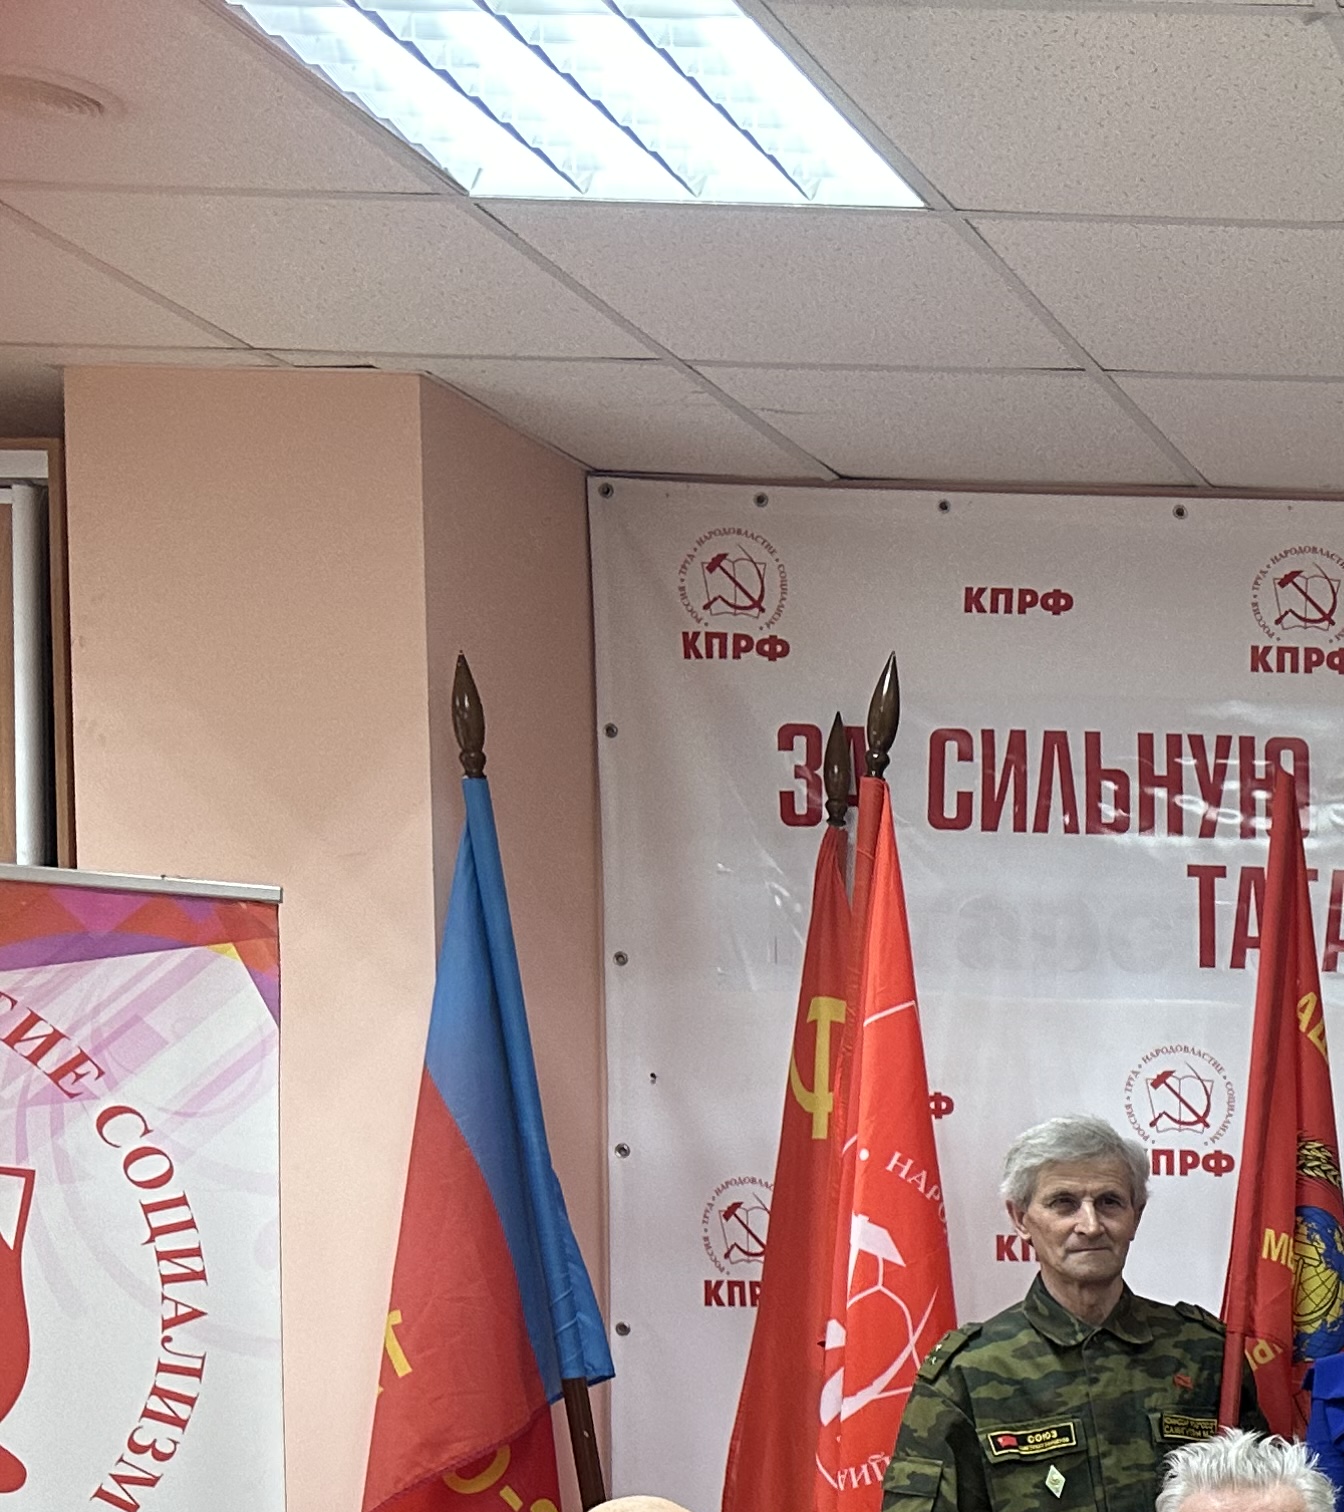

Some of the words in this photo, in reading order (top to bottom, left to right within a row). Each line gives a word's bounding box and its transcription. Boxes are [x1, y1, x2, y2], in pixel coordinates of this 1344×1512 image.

[964, 587, 1073, 615] КПРФ
[681, 631, 790, 661] КПРФ
[928, 728, 1310, 838] СИЛЬНУЮ
[1151, 1148, 1235, 1177] ПРФ
[996, 1234, 1040, 1262] КП
[704, 1280, 762, 1307] КПР
